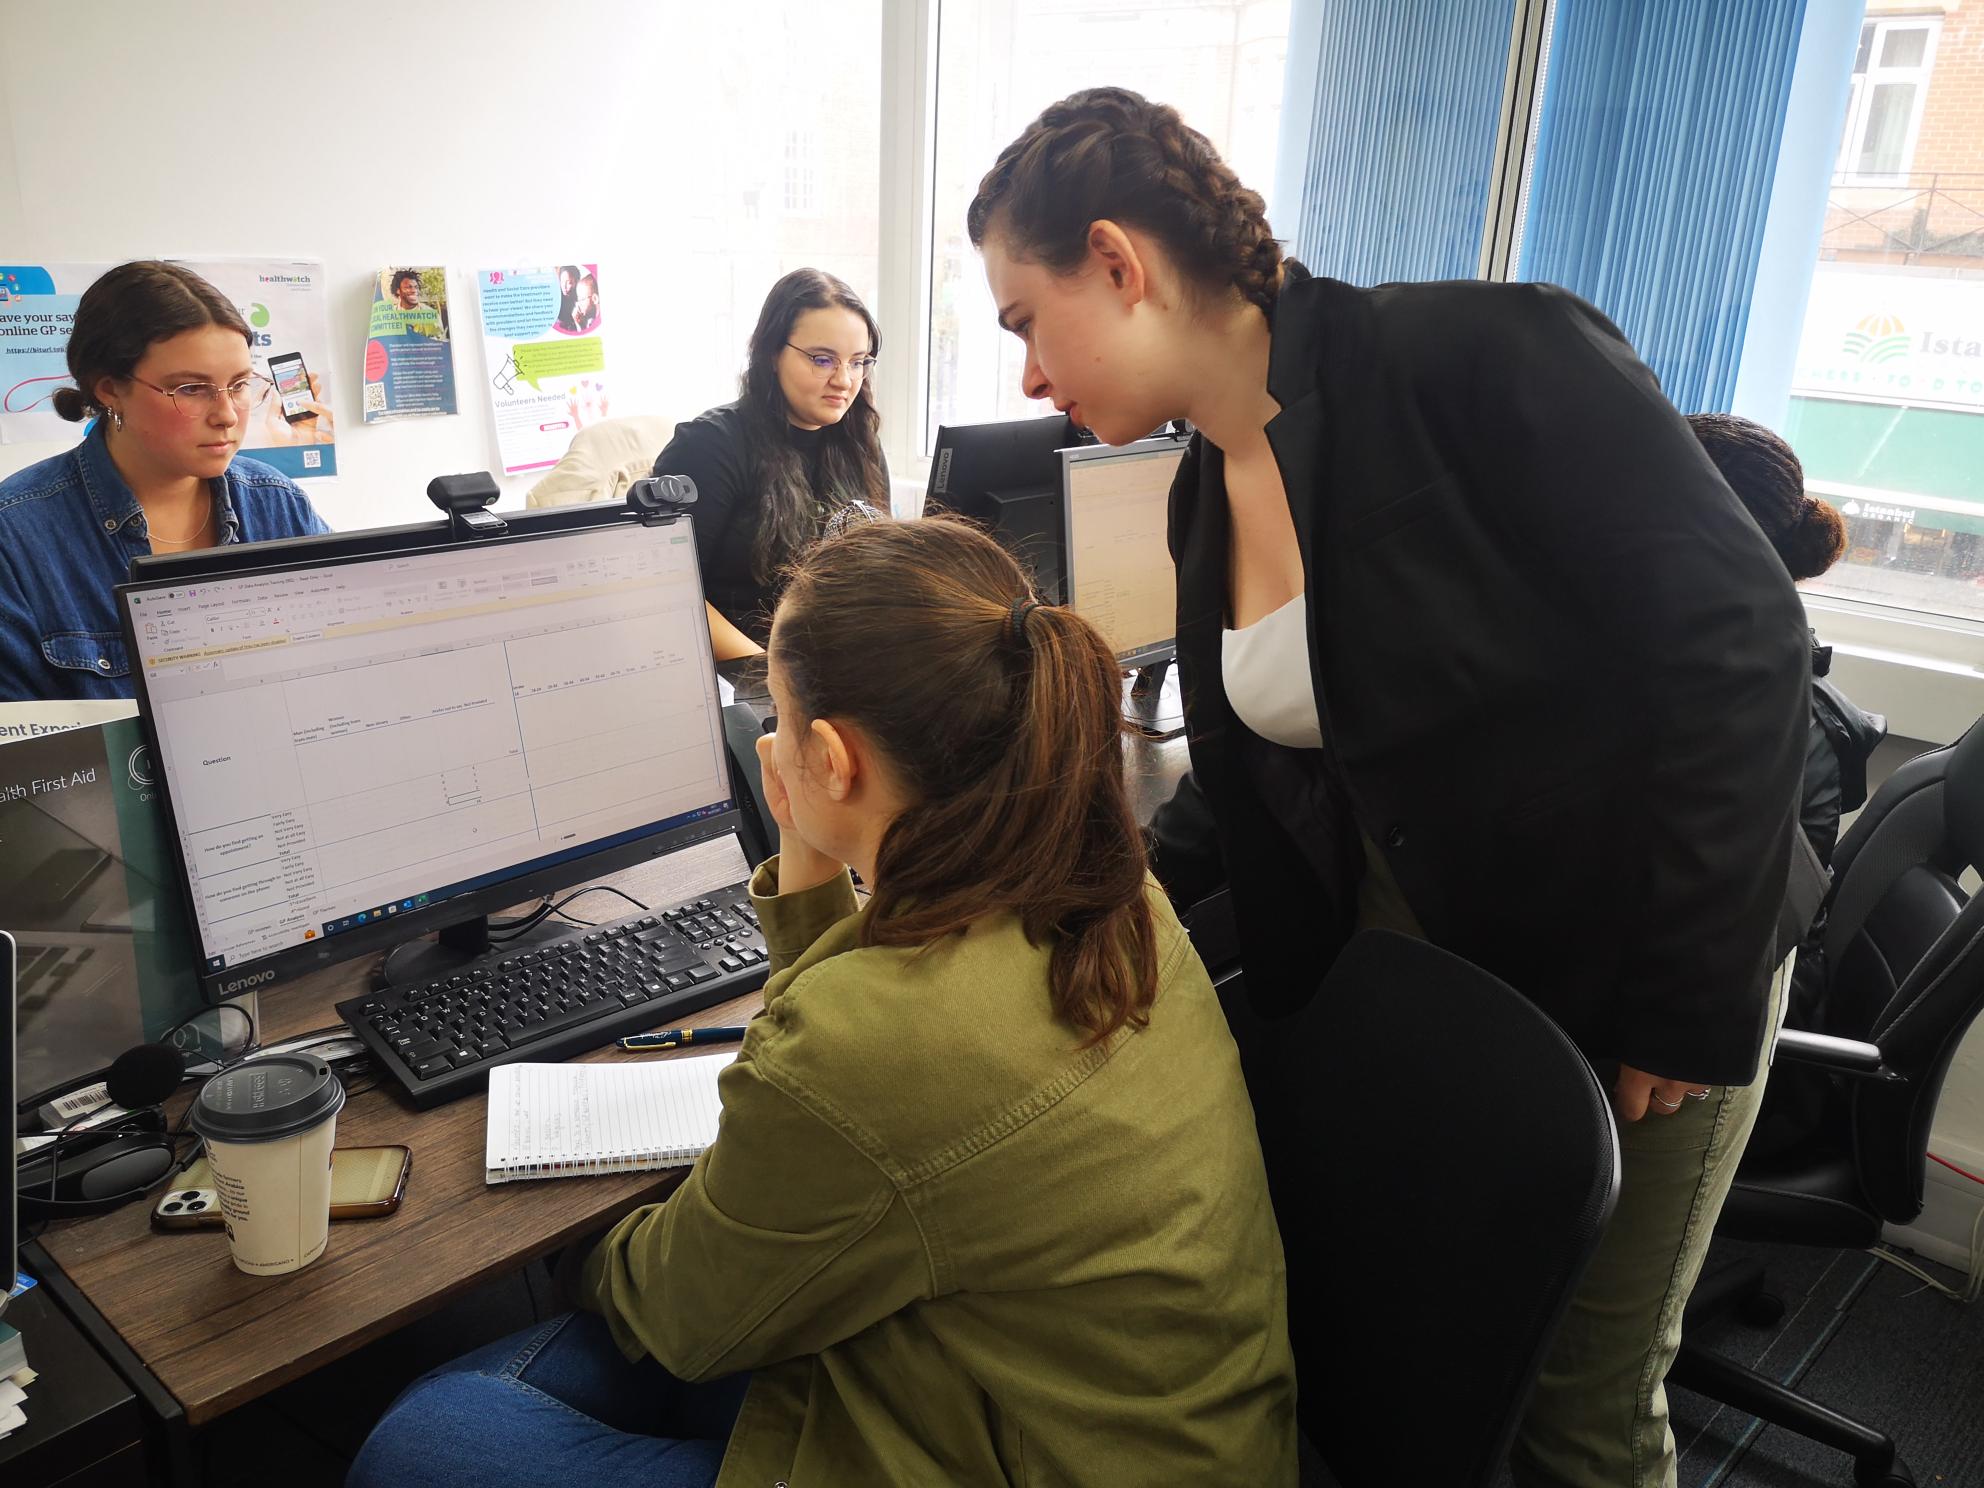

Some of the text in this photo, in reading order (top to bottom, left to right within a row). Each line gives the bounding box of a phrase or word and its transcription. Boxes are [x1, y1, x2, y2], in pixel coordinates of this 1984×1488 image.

[259, 275, 311, 283] healthwatch
[24, 314, 53, 324] your
[0, 326, 38, 336] online
[40, 326, 56, 335] GP
[494, 393, 566, 408] Volunteers Needed
[938, 452, 949, 488] Lenovo
[1864, 503, 1915, 518] Istanbul
[0, 724, 27, 736] ent
[202, 754, 232, 767] Question
[32, 774, 68, 796] First
[71, 768, 96, 786] Aid
[218, 970, 276, 996] Lenovo
